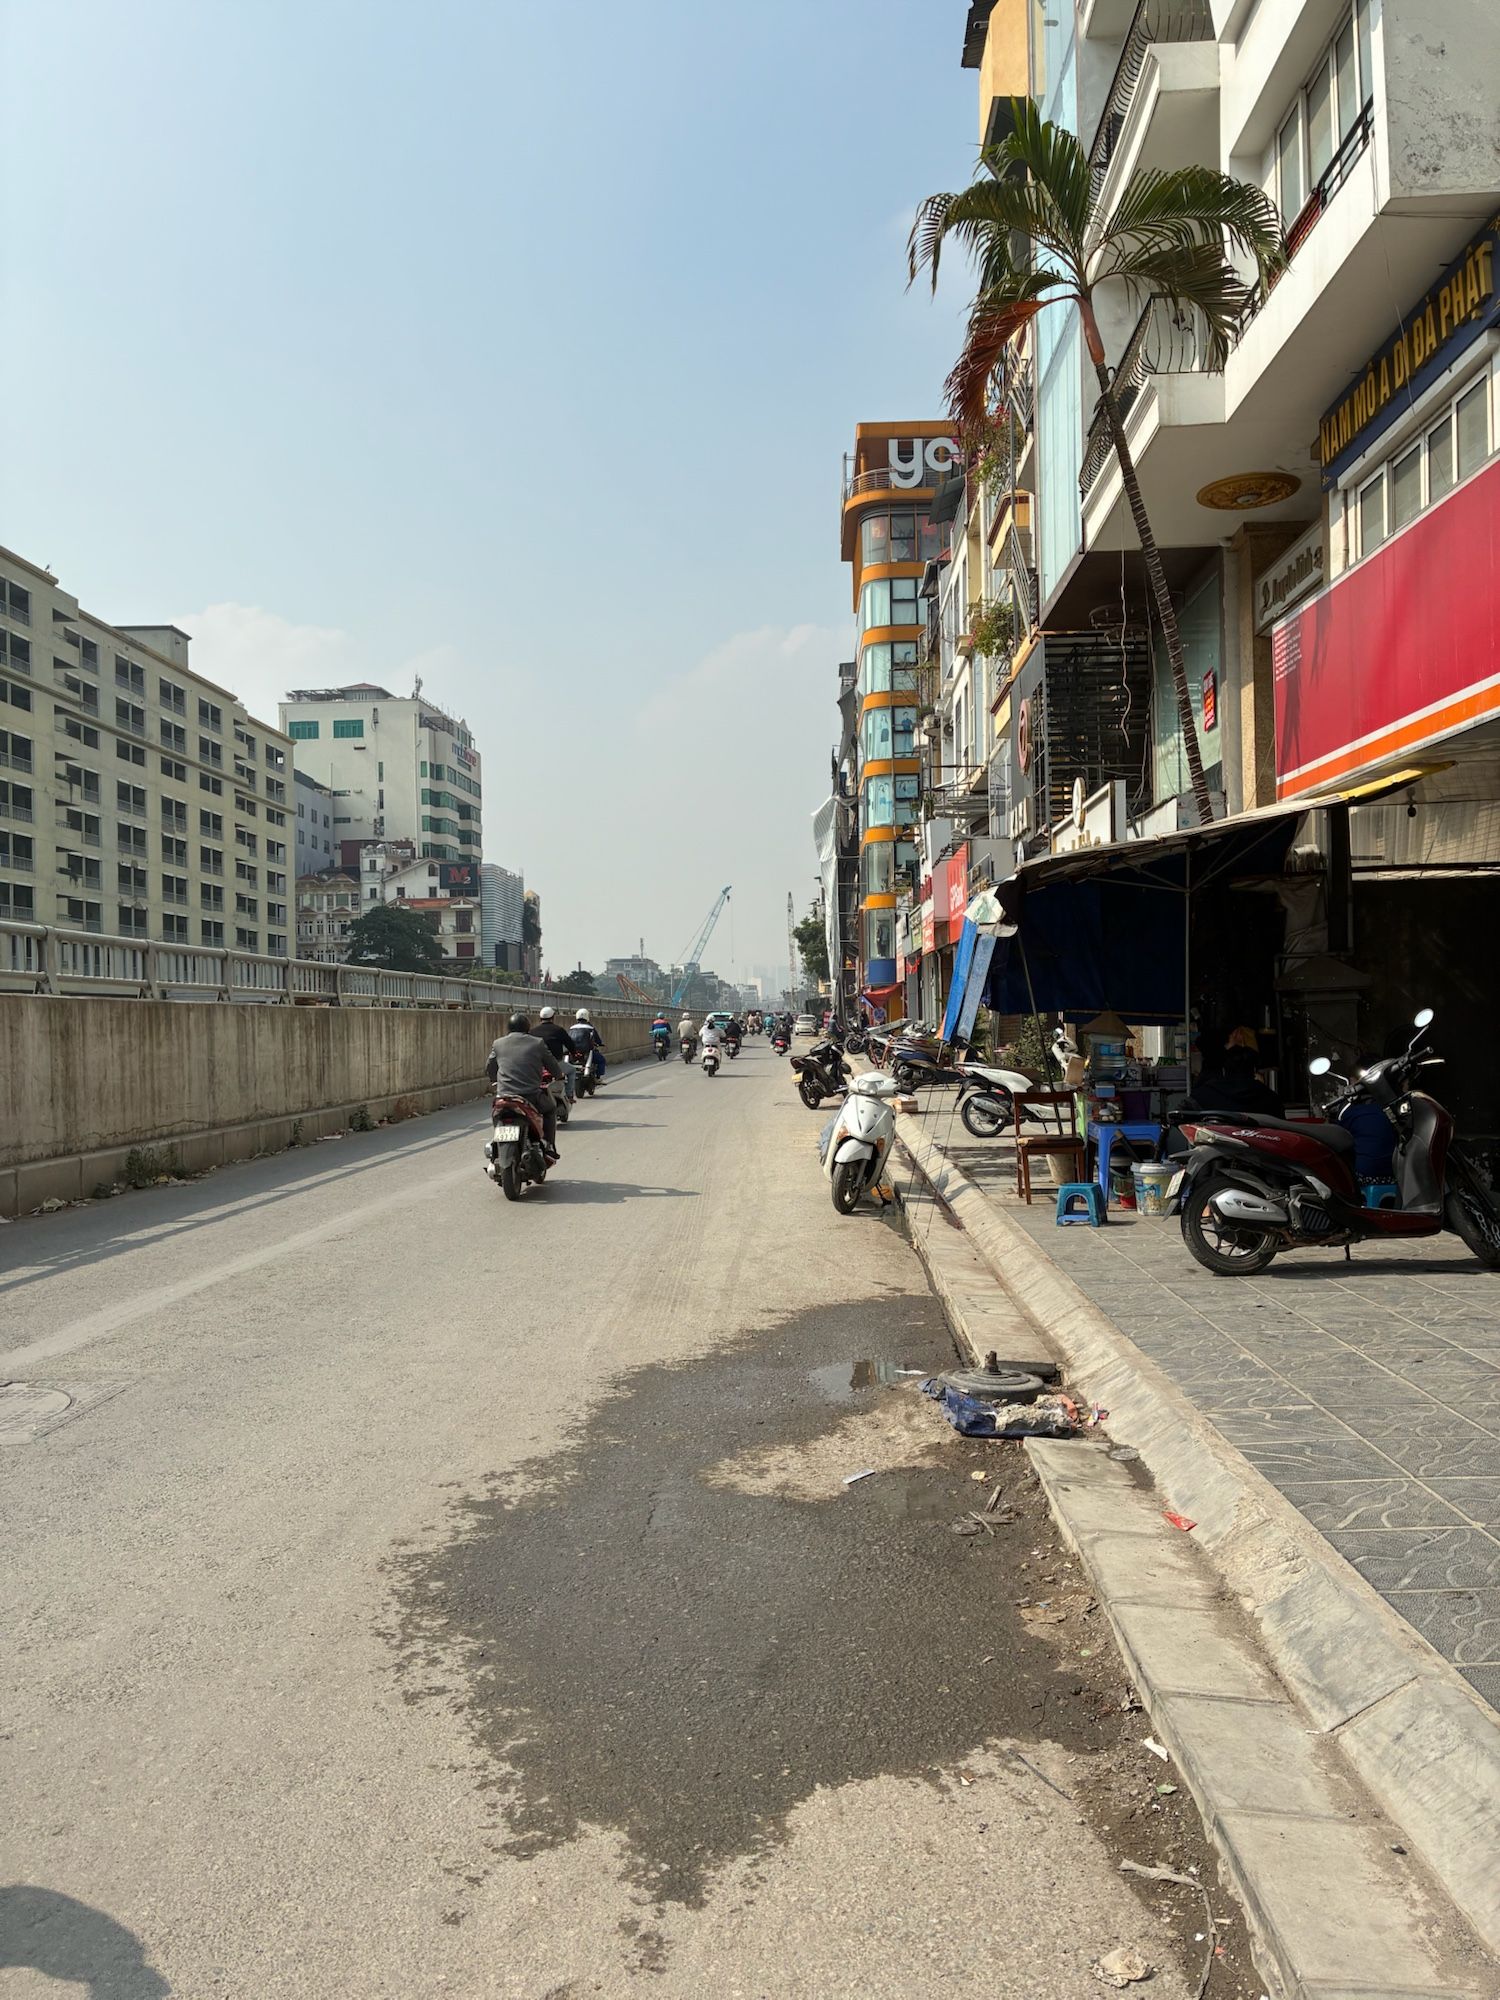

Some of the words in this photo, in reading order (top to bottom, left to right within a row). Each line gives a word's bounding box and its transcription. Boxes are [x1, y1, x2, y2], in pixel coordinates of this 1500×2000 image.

[1321, 398, 1351, 467] NAM
[1354, 361, 1376, 432] MÔ
[1380, 356, 1391, 405] A
[1412, 296, 1437, 368] ĐÀ
[1439, 240, 1494, 340] PHẬT
